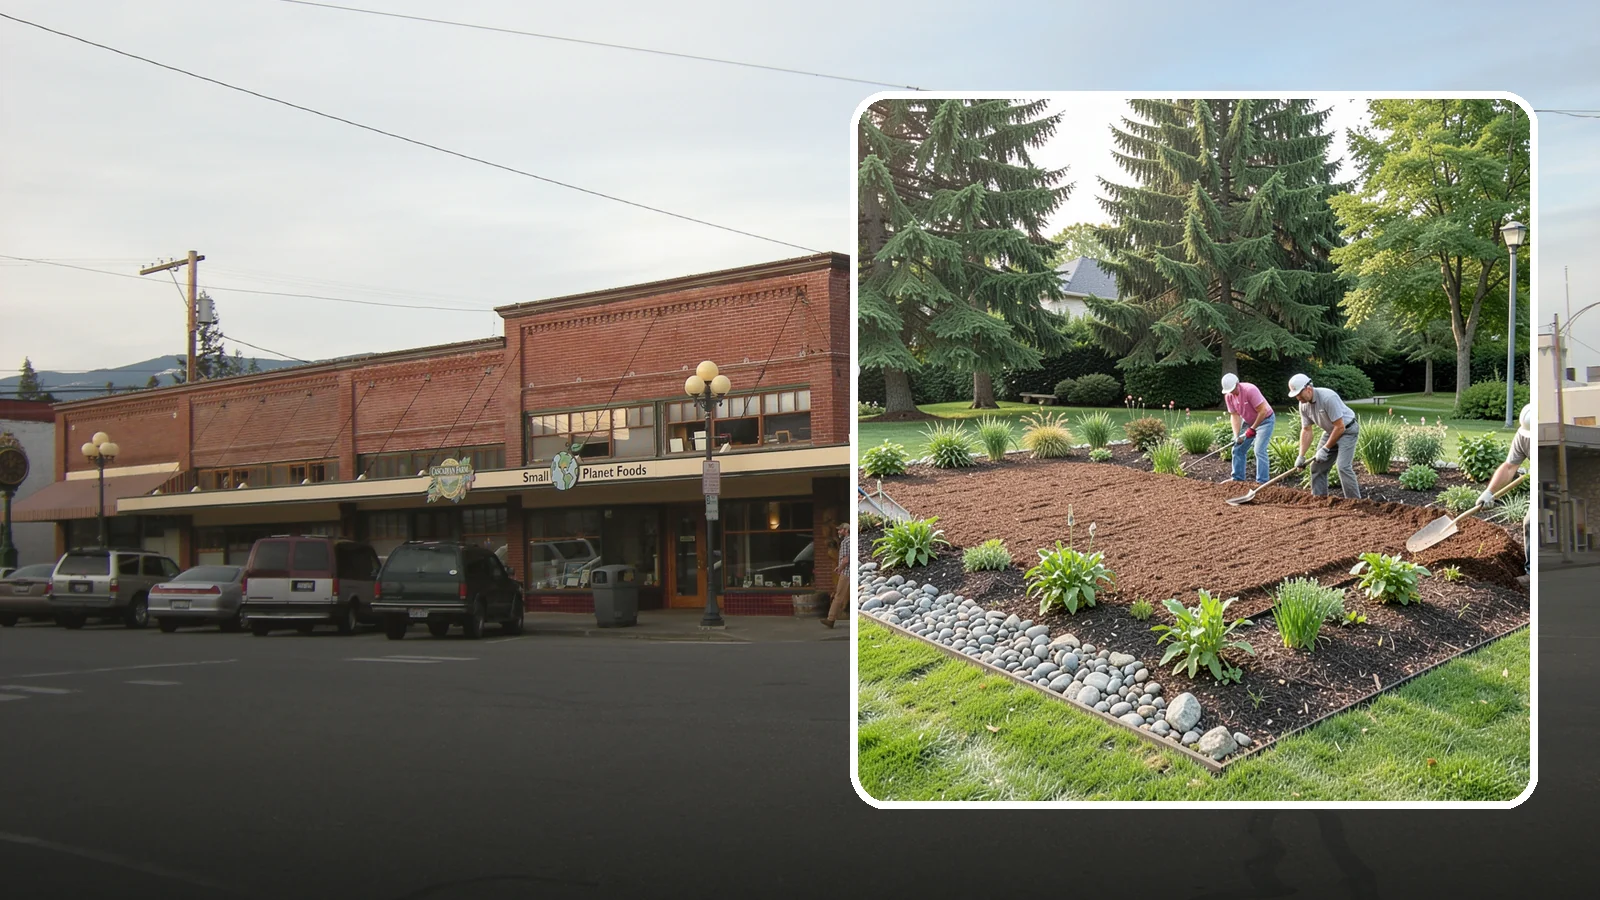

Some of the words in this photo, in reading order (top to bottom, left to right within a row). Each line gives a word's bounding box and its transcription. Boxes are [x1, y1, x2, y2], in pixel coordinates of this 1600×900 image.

[522, 471, 549, 483] Small
[582, 468, 614, 479] Planet
[616, 464, 647, 477] Foods
